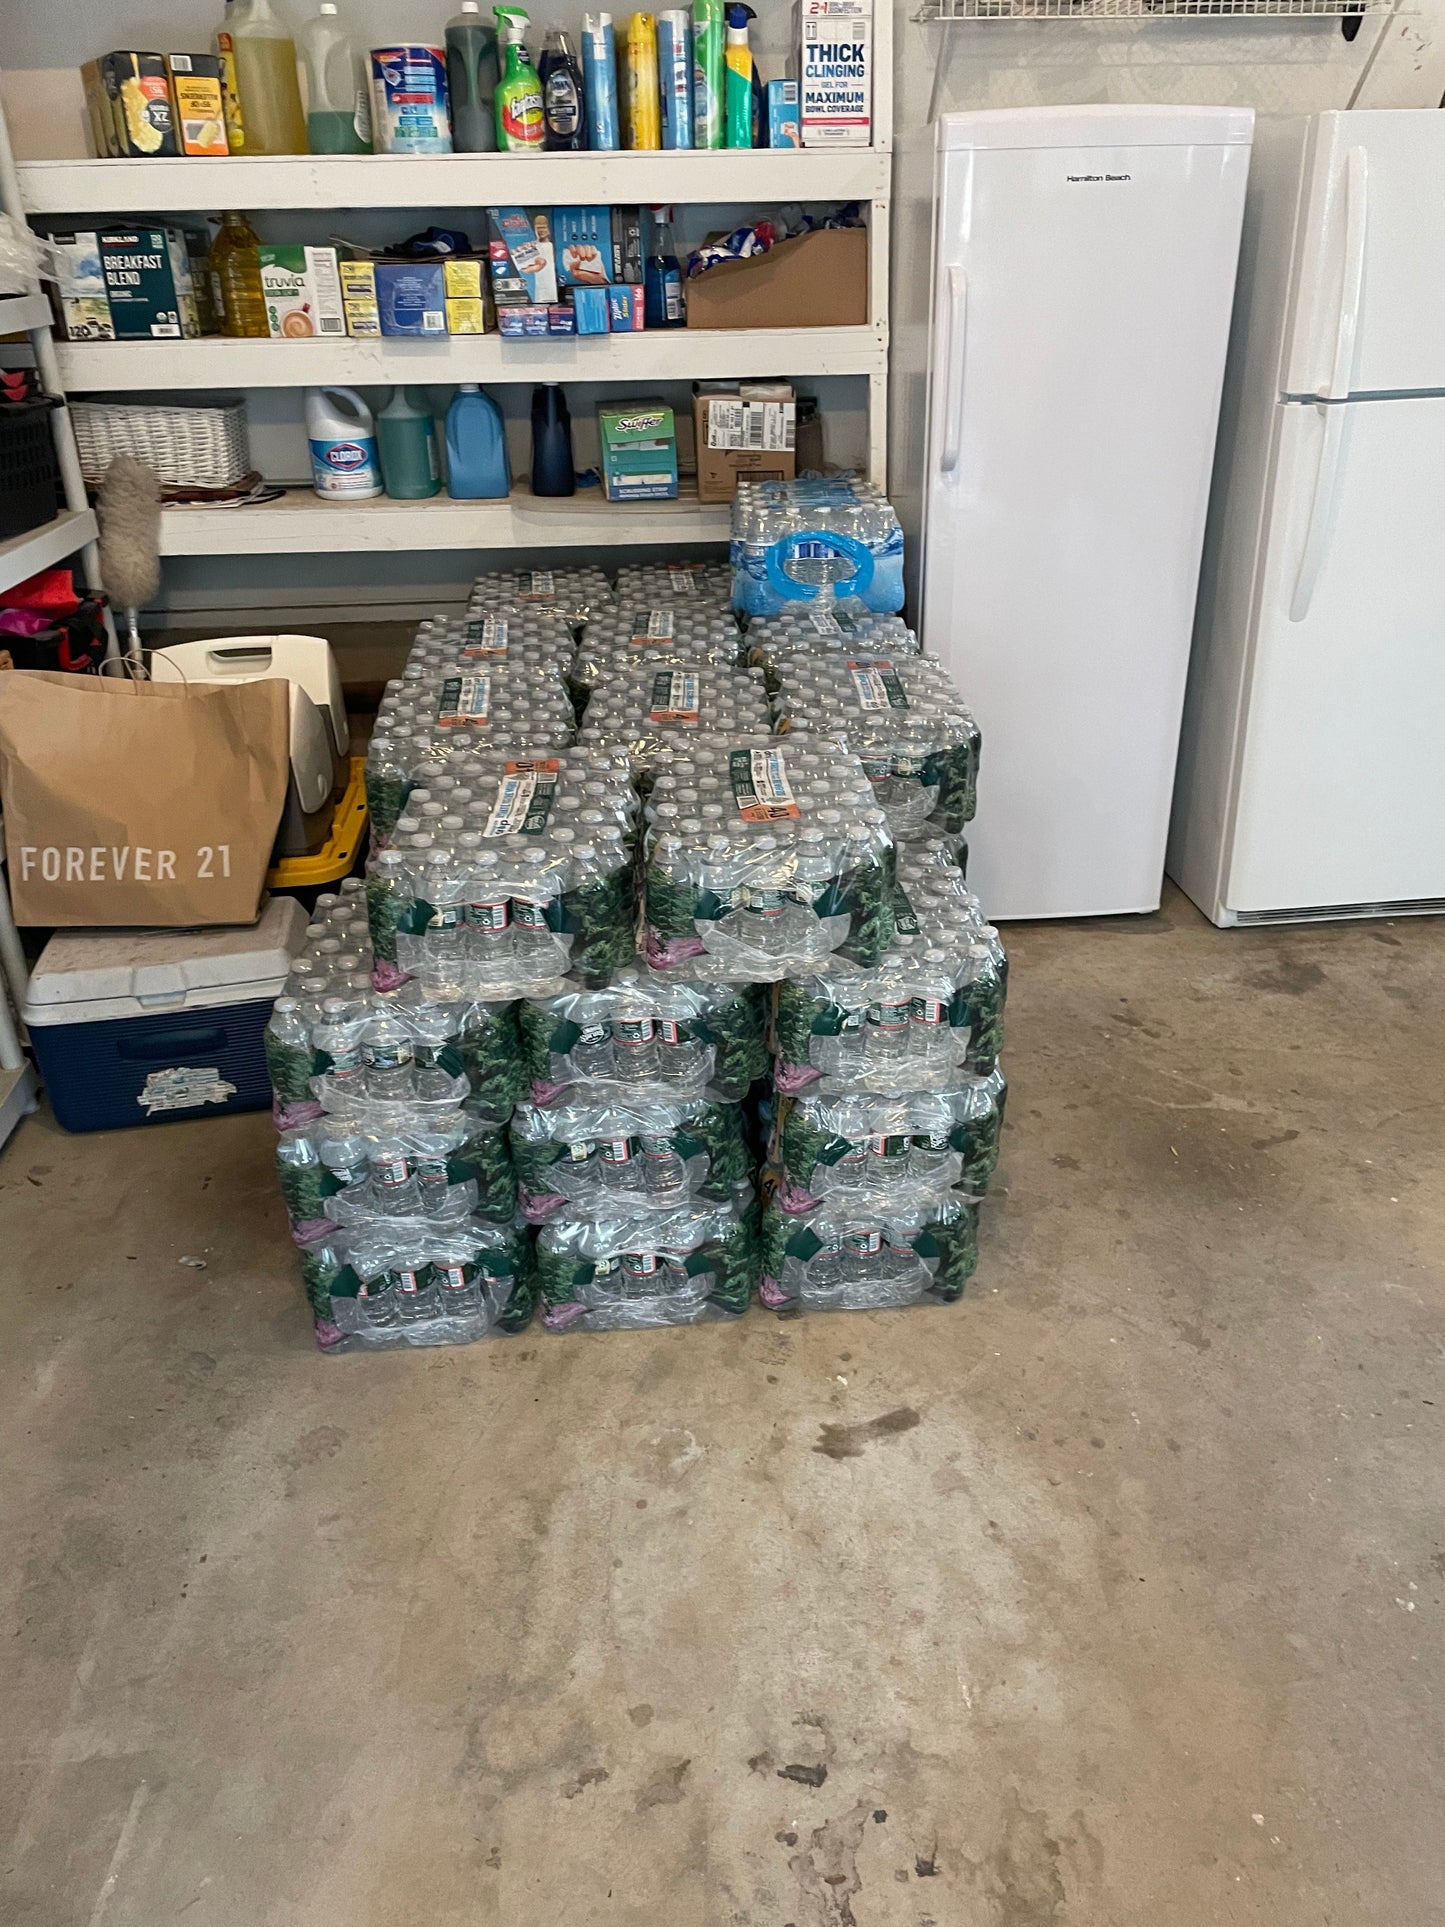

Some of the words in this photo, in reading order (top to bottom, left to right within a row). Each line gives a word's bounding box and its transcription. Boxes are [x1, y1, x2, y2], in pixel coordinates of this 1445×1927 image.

[806, 44, 865, 62] THICK
[806, 64, 865, 78] CLINGING
[805, 92, 864, 103] MAXIMUM
[154, 111, 169, 122] 2X
[103, 255, 162, 269] BREAKFAST
[106, 271, 140, 286] BLEND
[265, 274, 305, 288] truvia
[610, 298, 622, 320] Ziploc
[621, 295, 629, 318] Slider
[68, 325, 91, 336] 120
[615, 417, 663, 431] Swiffer
[330, 450, 363, 462] CLOROX
[20, 846, 177, 882] FOREVER
[196, 844, 231, 879] 21
